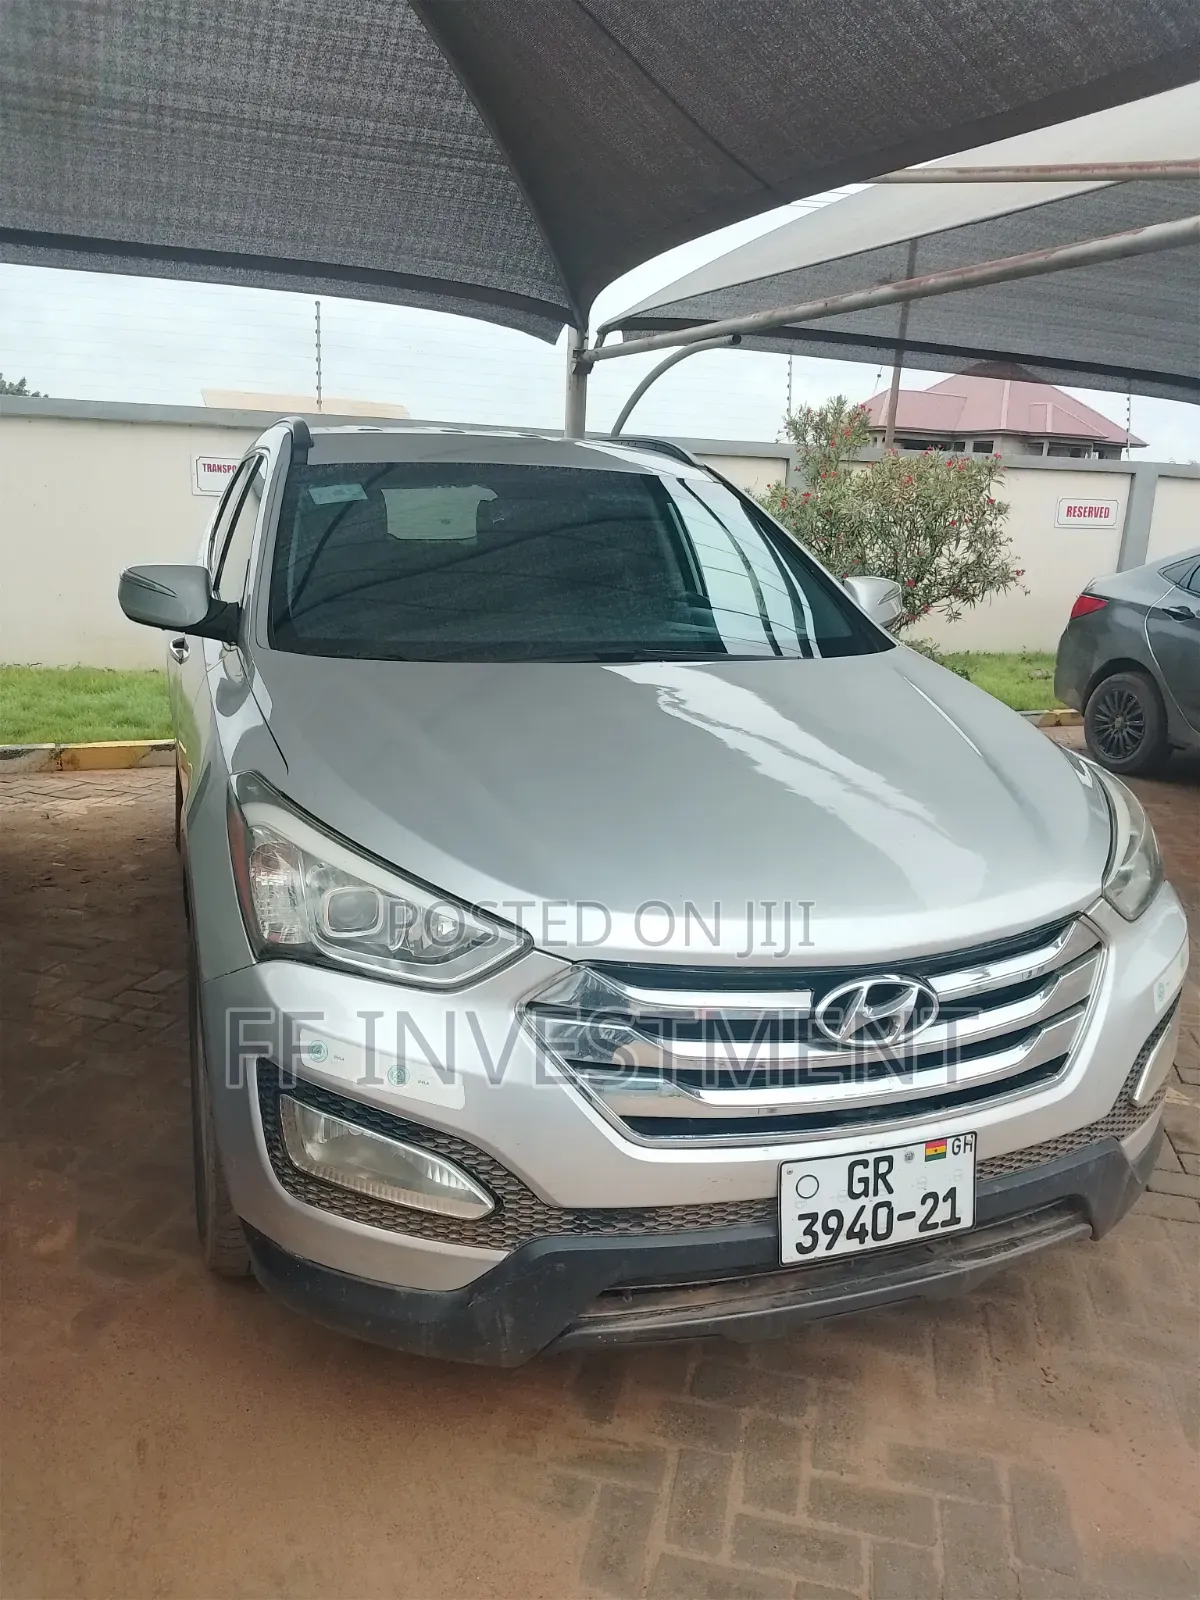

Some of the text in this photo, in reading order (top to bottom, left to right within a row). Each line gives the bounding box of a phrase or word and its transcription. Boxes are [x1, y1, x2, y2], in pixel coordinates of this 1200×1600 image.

[1066, 505, 1110, 519] RESERVED
[951, 1133, 974, 1156] GH
[847, 1154, 895, 1201] GR
[795, 1186, 962, 1255] 3940-21
